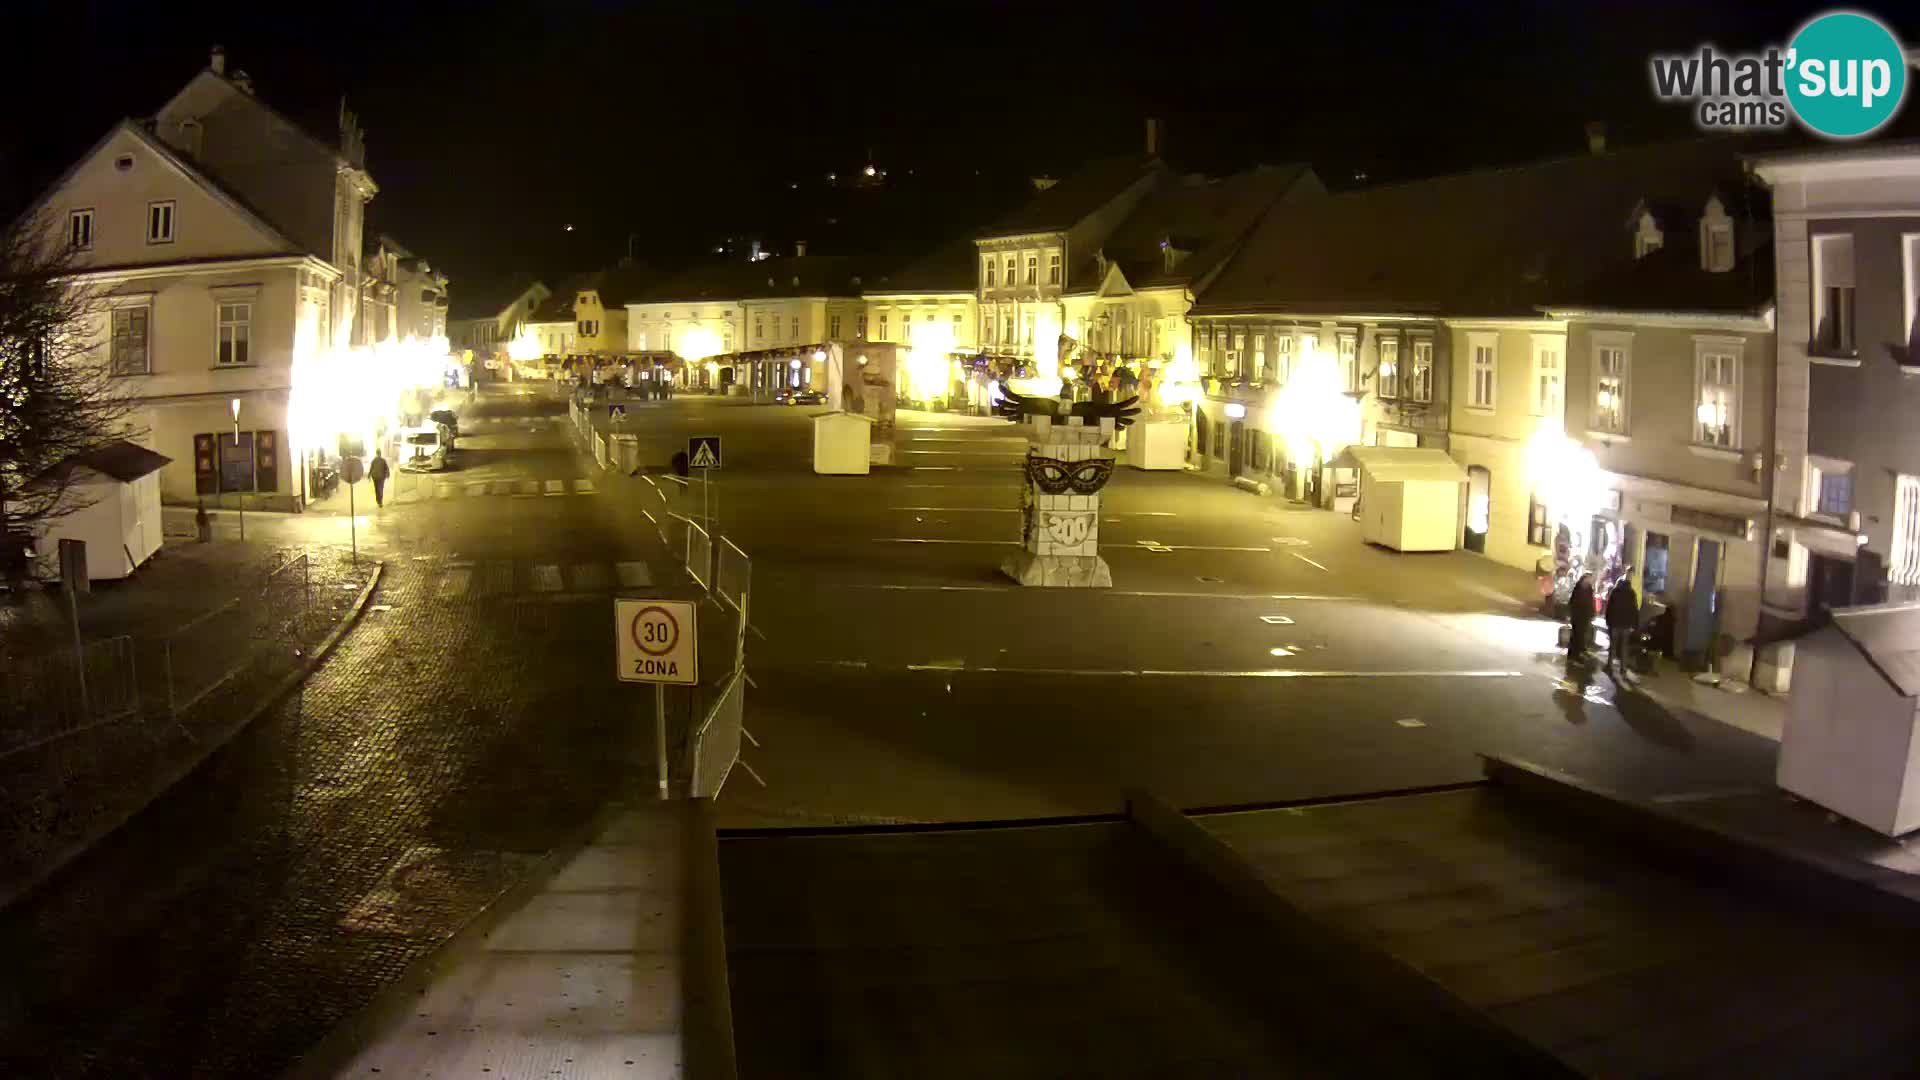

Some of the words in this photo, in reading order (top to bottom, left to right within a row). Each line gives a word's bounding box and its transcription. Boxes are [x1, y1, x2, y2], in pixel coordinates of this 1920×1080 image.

[1047, 515, 1088, 545] 200
[644, 622, 668, 642] 30
[634, 659, 678, 676] ZONA
